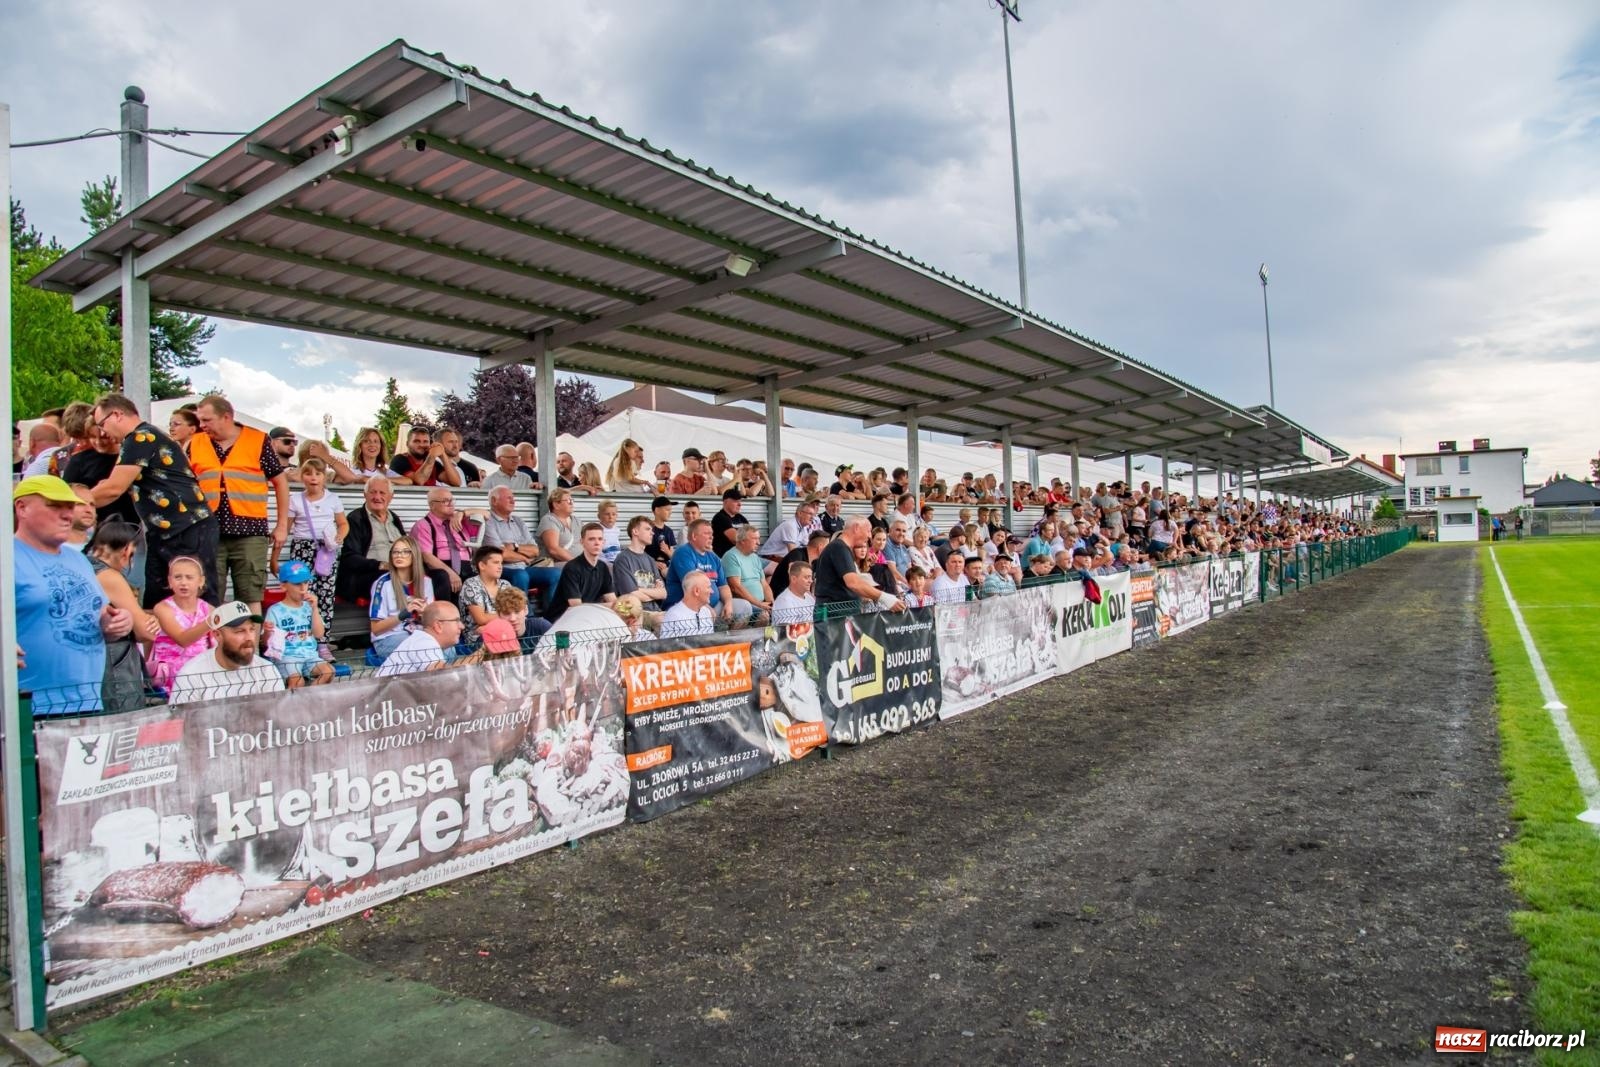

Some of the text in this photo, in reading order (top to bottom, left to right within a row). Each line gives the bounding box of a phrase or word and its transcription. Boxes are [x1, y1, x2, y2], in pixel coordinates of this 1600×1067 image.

[629, 650, 746, 692] KREWETKA
[886, 676, 901, 692] OD
[902, 674, 910, 689] A
[912, 670, 928, 687] DO
[633, 694, 658, 707] SKLEP
[660, 688, 690, 703] RYBNY
[634, 714, 651, 728] RYBY
[652, 707, 680, 723] ŚWIEŻE,
[880, 704, 911, 733] 092
[912, 697, 936, 724] 363
[206, 700, 438, 759] Producent kiełbasy
[365, 706, 532, 753] surowo-dojrzewającej
[659, 719, 684, 732] MORSKIE
[637, 749, 760, 790] UL. ZBOROWA 5A tel. 32 415 22 32
[637, 796, 651, 807] UL.
[652, 784, 680, 802] OCICKA
[682, 780, 688, 792] 5
[693, 778, 705, 789] tel.
[705, 776, 714, 785] 32
[714, 771, 726, 783] 666
[731, 767, 744, 778] 111
[62, 787, 93, 801] ZAKŁAD
[212, 758, 459, 844] kiełbasa
[329, 764, 535, 882] szefa
[55, 981, 90, 1000] Zakład
[90, 953, 193, 988] Rzeźniczo-Wędliniarski
[191, 941, 226, 958] Ernestyn
[226, 932, 254, 948] Janeta
[265, 925, 275, 936] ul.
